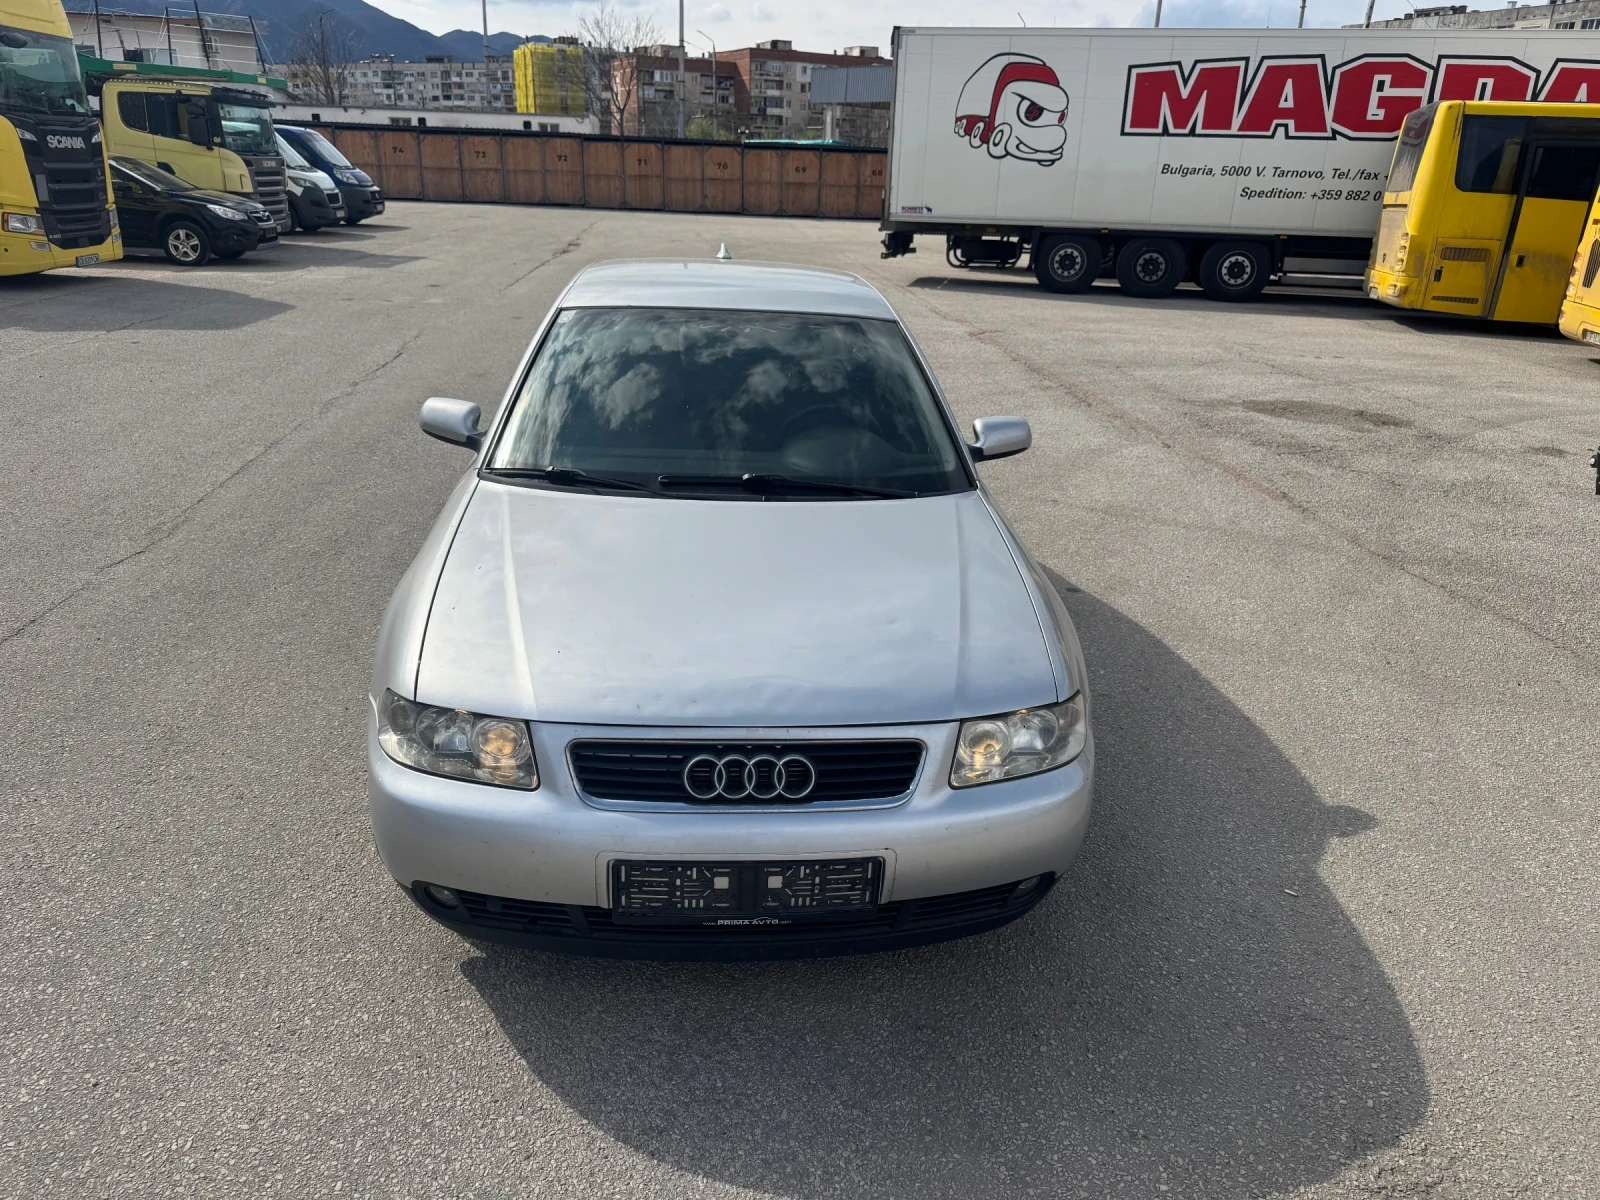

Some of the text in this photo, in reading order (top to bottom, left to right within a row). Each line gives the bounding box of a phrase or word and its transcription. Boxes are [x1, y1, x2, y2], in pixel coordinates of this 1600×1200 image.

[46, 134, 86, 148] SCANIA
[637, 158, 648, 166] 71
[717, 162, 728, 170] 70
[1161, 164, 1216, 178] Bulgaria,
[1220, 166, 1251, 177] 5000
[1256, 166, 1266, 178] V.
[1272, 166, 1325, 180] Tarnovo,
[1332, 168, 1380, 180] Tel./fax
[1240, 186, 1307, 200] Spedition:
[1310, 190, 1342, 200] +359
[1345, 190, 1370, 201] 882
